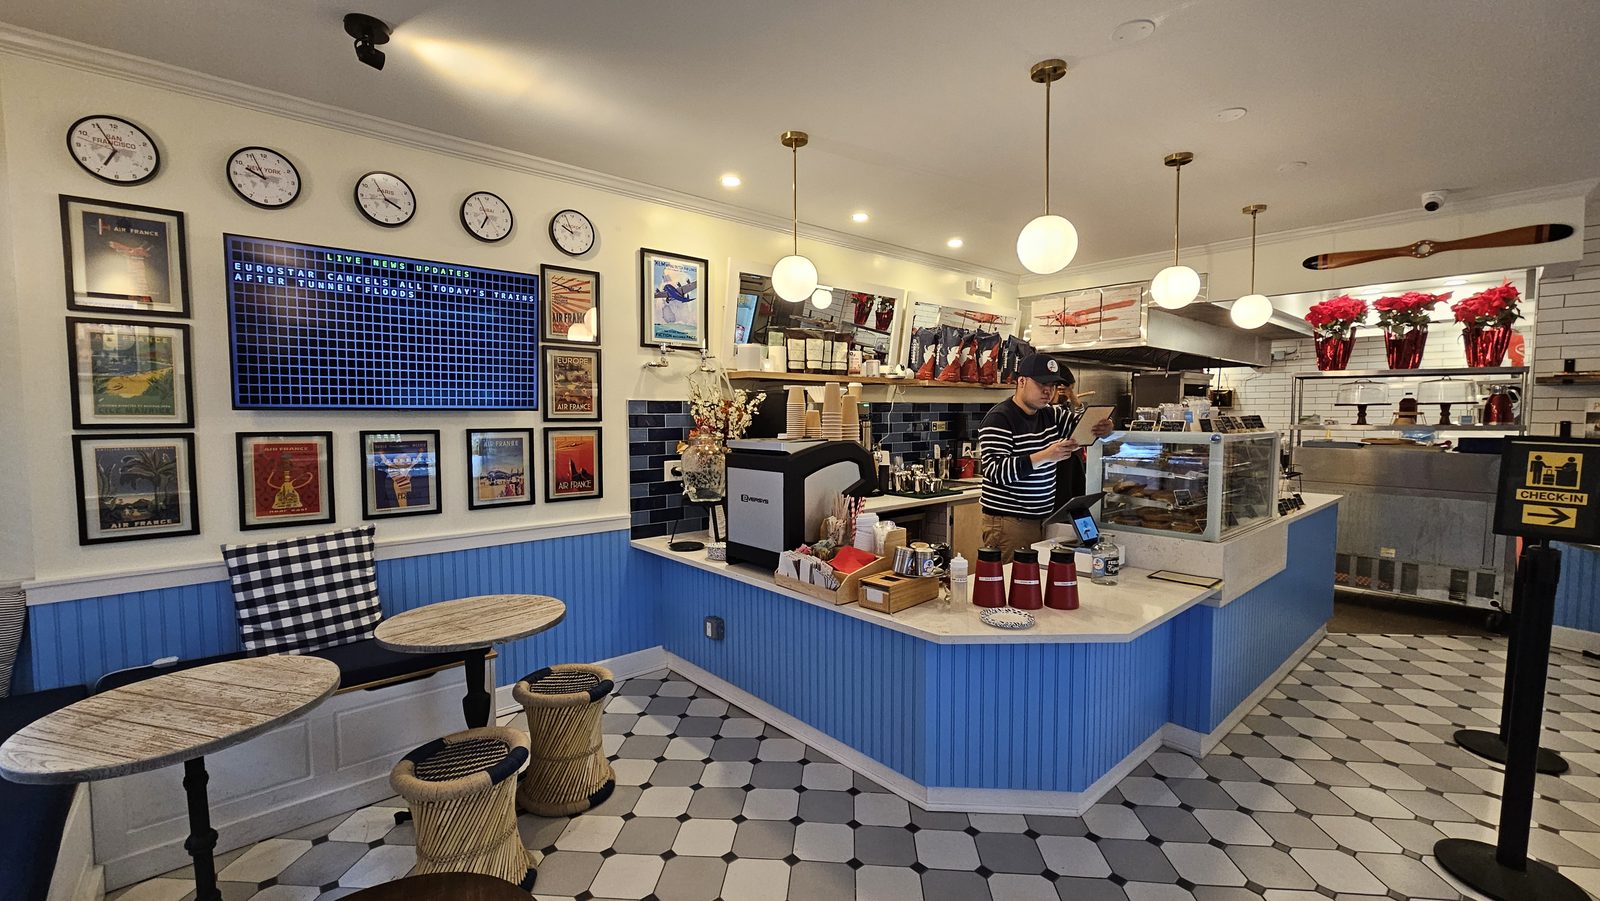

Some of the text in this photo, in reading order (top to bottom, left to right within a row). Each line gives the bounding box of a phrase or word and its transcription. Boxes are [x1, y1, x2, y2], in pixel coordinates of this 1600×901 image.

[92, 136, 136, 150] FRANCISCO
[106, 133, 122, 142] SAN
[247, 164, 281, 175] NEW YORK
[377, 188, 394, 196] PARIS
[130, 229, 159, 237] FRANCE
[326, 253, 470, 278] LIVE NEWS UPDATES
[234, 262, 534, 302] EUROSTAR CANCELS ALL TODAY'S TRAINS
[234, 273, 415, 298] AFTER TUNNEL FLOODS
[553, 312, 586, 324] AIR FRAN
[571, 480, 592, 489] FRANCE
[1520, 490, 1584, 503] CHECK-IN
